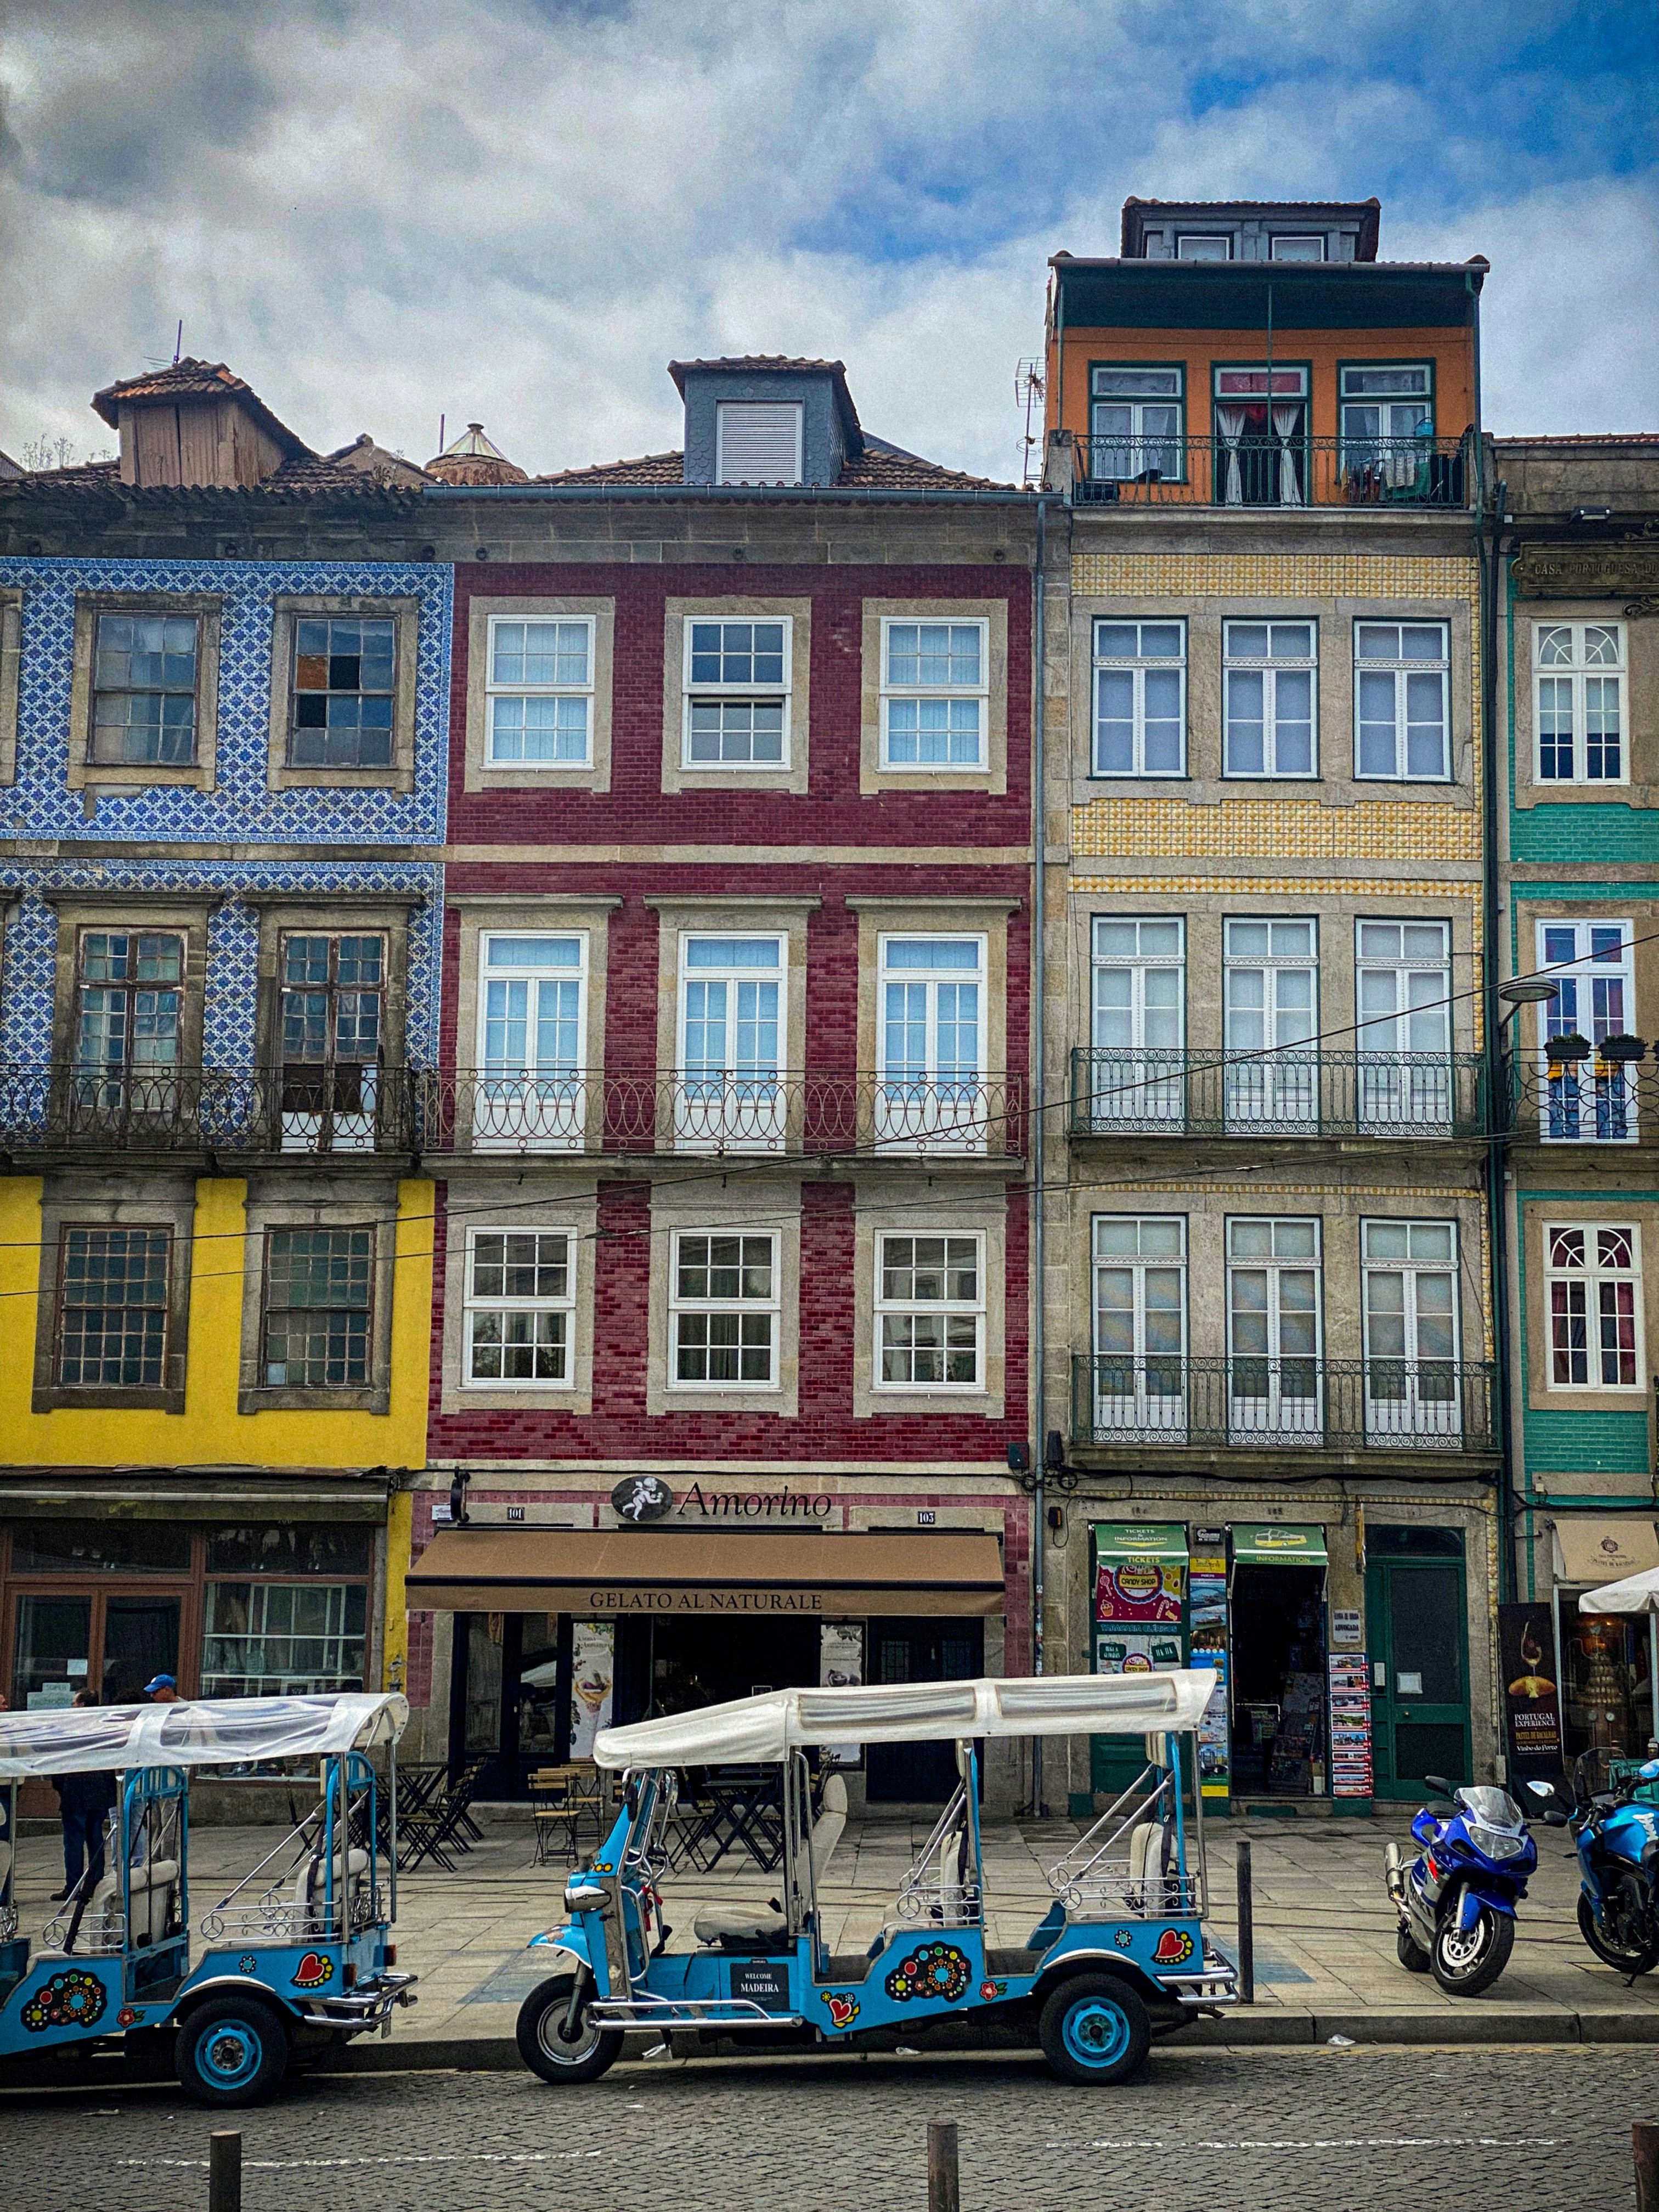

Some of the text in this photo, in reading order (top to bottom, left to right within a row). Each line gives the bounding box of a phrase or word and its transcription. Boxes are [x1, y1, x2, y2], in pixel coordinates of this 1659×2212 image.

[1535, 563, 1563, 575] CASA
[676, 1481, 831, 1516] Amorino
[509, 1508, 522, 1519] 101
[919, 1513, 934, 1523] 103
[590, 1592, 822, 1610] GELATO AL NATURALE
[1515, 1713, 1555, 1721] PORTUGAL
[741, 1983, 779, 1993] MADEIRA
